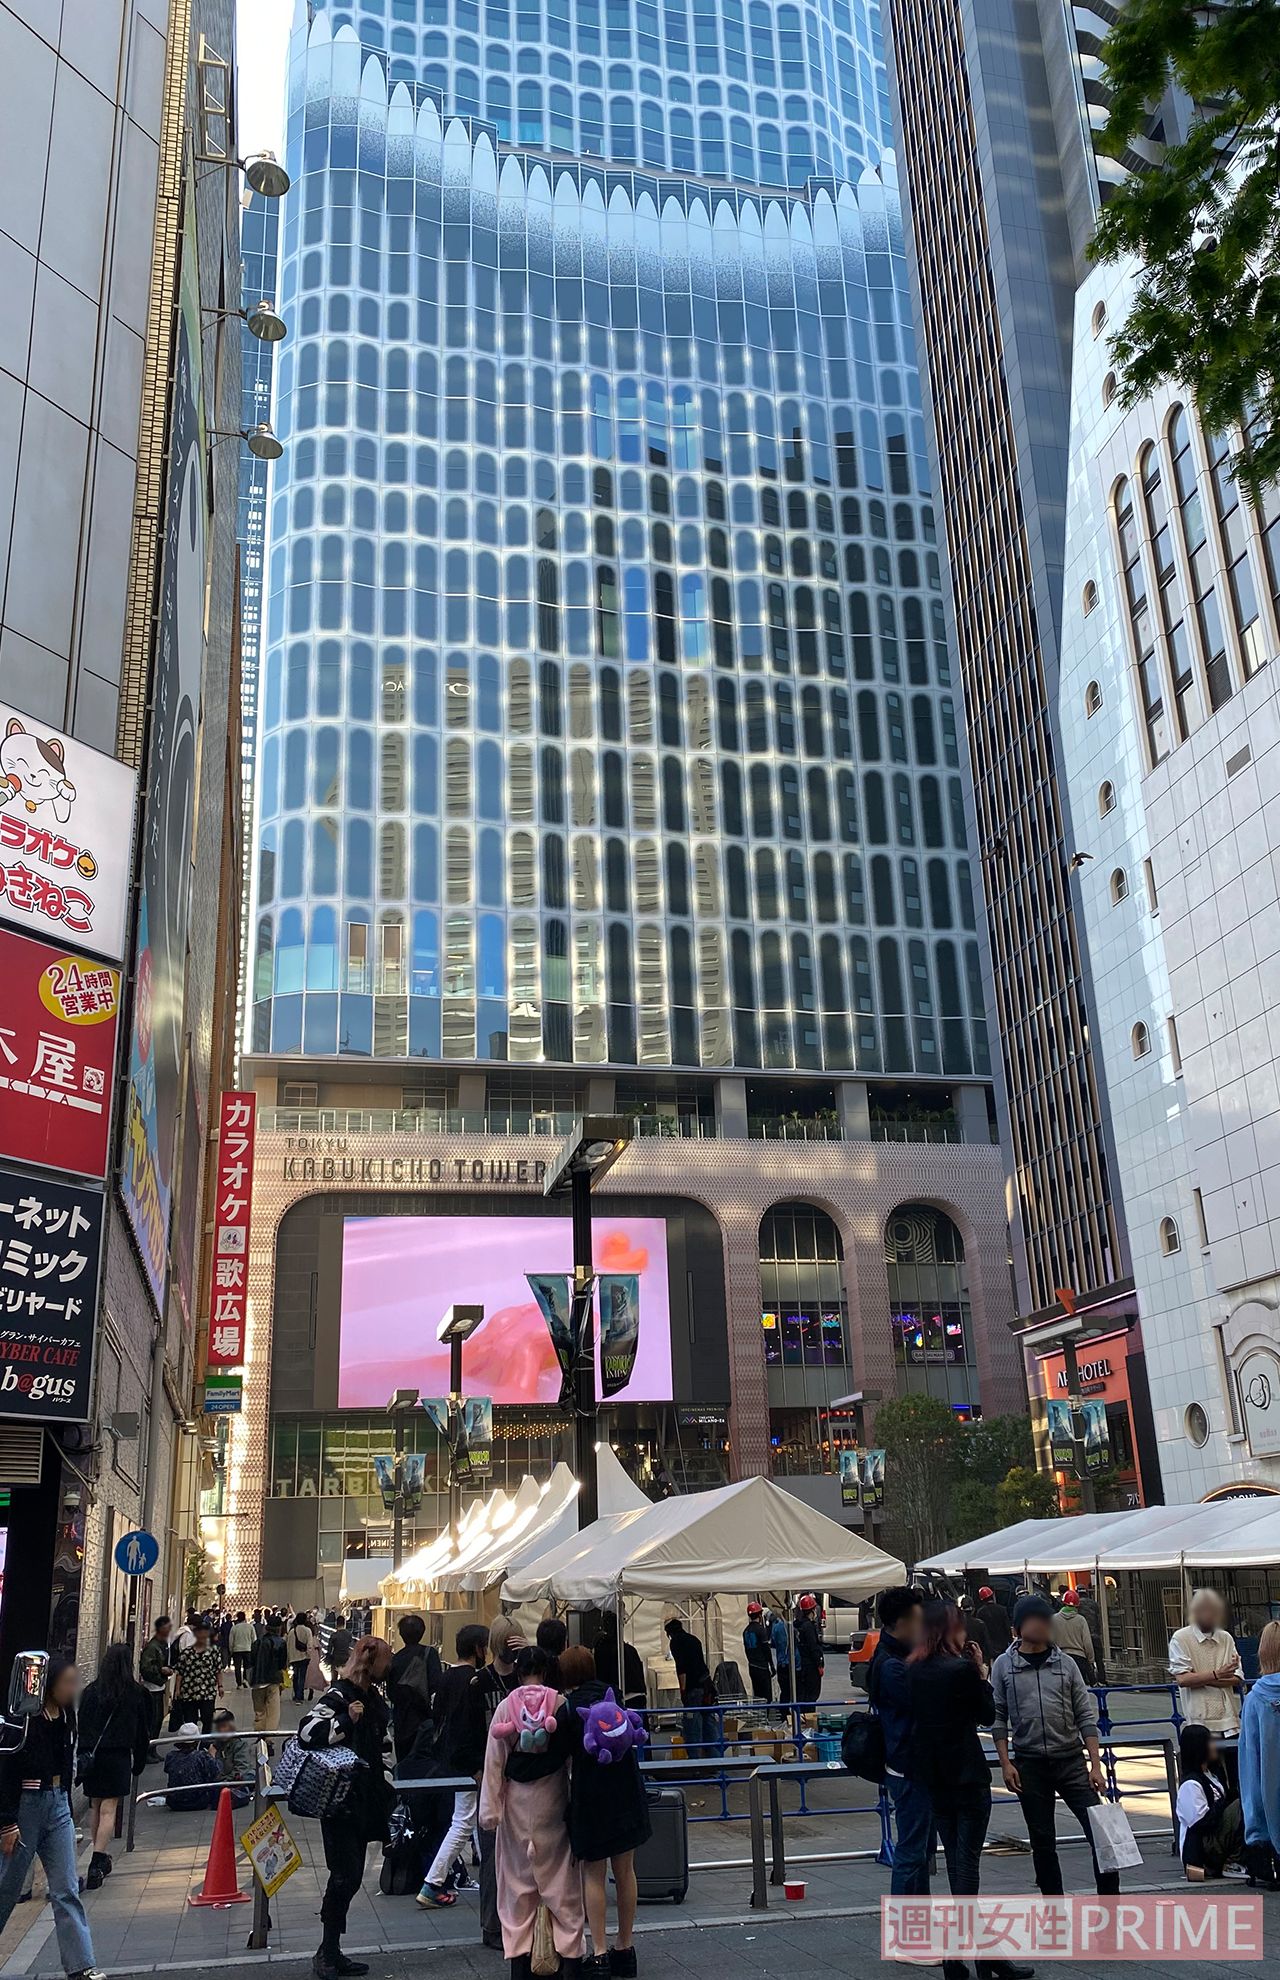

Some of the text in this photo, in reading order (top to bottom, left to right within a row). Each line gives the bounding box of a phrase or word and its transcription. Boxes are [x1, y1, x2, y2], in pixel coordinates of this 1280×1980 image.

[1, 815, 78, 869] ラオケ
[0, 864, 94, 932] きねこ
[48, 964, 113, 995] 24時間
[61, 989, 114, 1017] 営業中
[285, 1137, 348, 1151] TOKYU
[283, 1157, 546, 1183] KABUKICHO TOWER
[213, 1100, 251, 1357] カラオケ 歌広場
[0, 1240, 88, 1282] ミック
[43, 1346, 80, 1367] CAFE
[1078, 1359, 1111, 1382] HOTEL
[207, 1390, 239, 1398] FamilyMart
